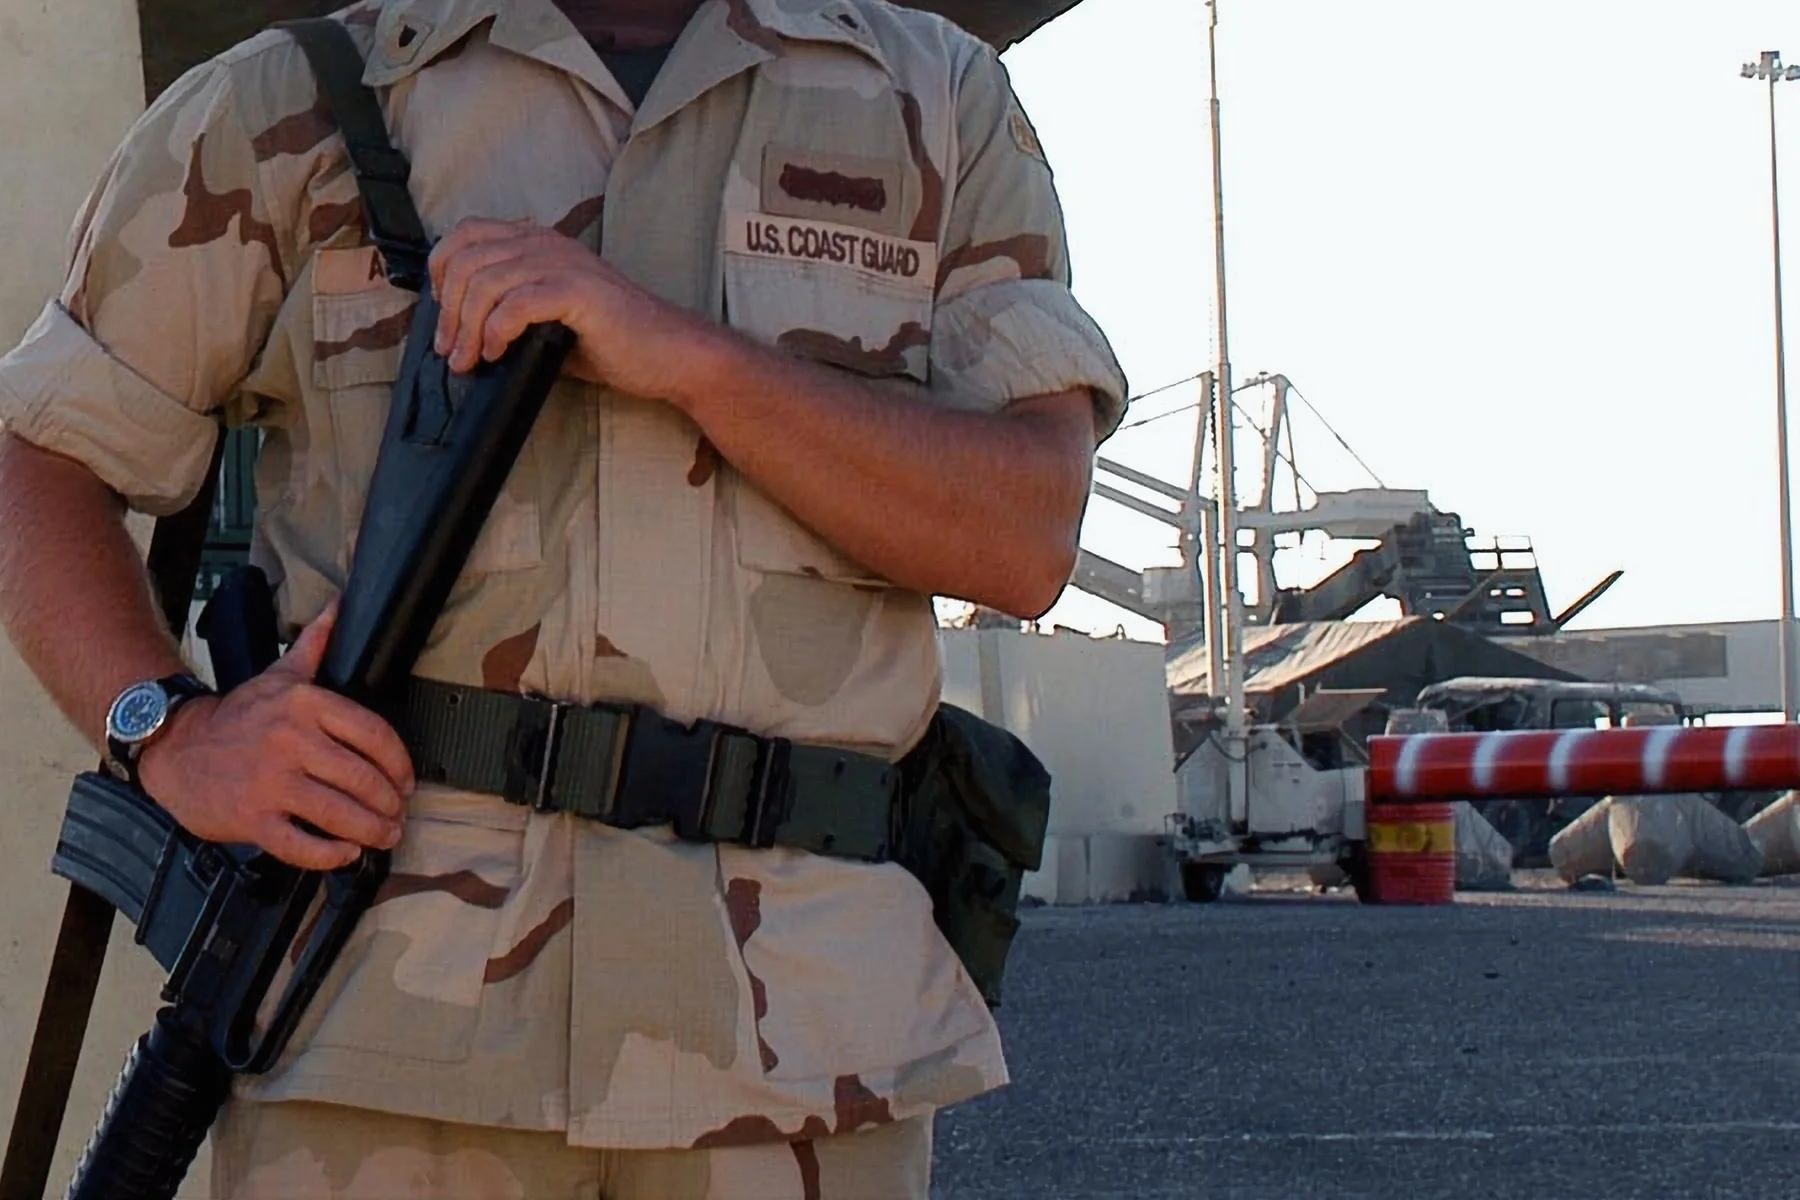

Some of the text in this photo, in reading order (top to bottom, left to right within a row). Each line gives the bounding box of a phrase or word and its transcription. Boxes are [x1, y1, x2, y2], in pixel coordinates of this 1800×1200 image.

[745, 220, 921, 277] U.S. COAST GUARD
